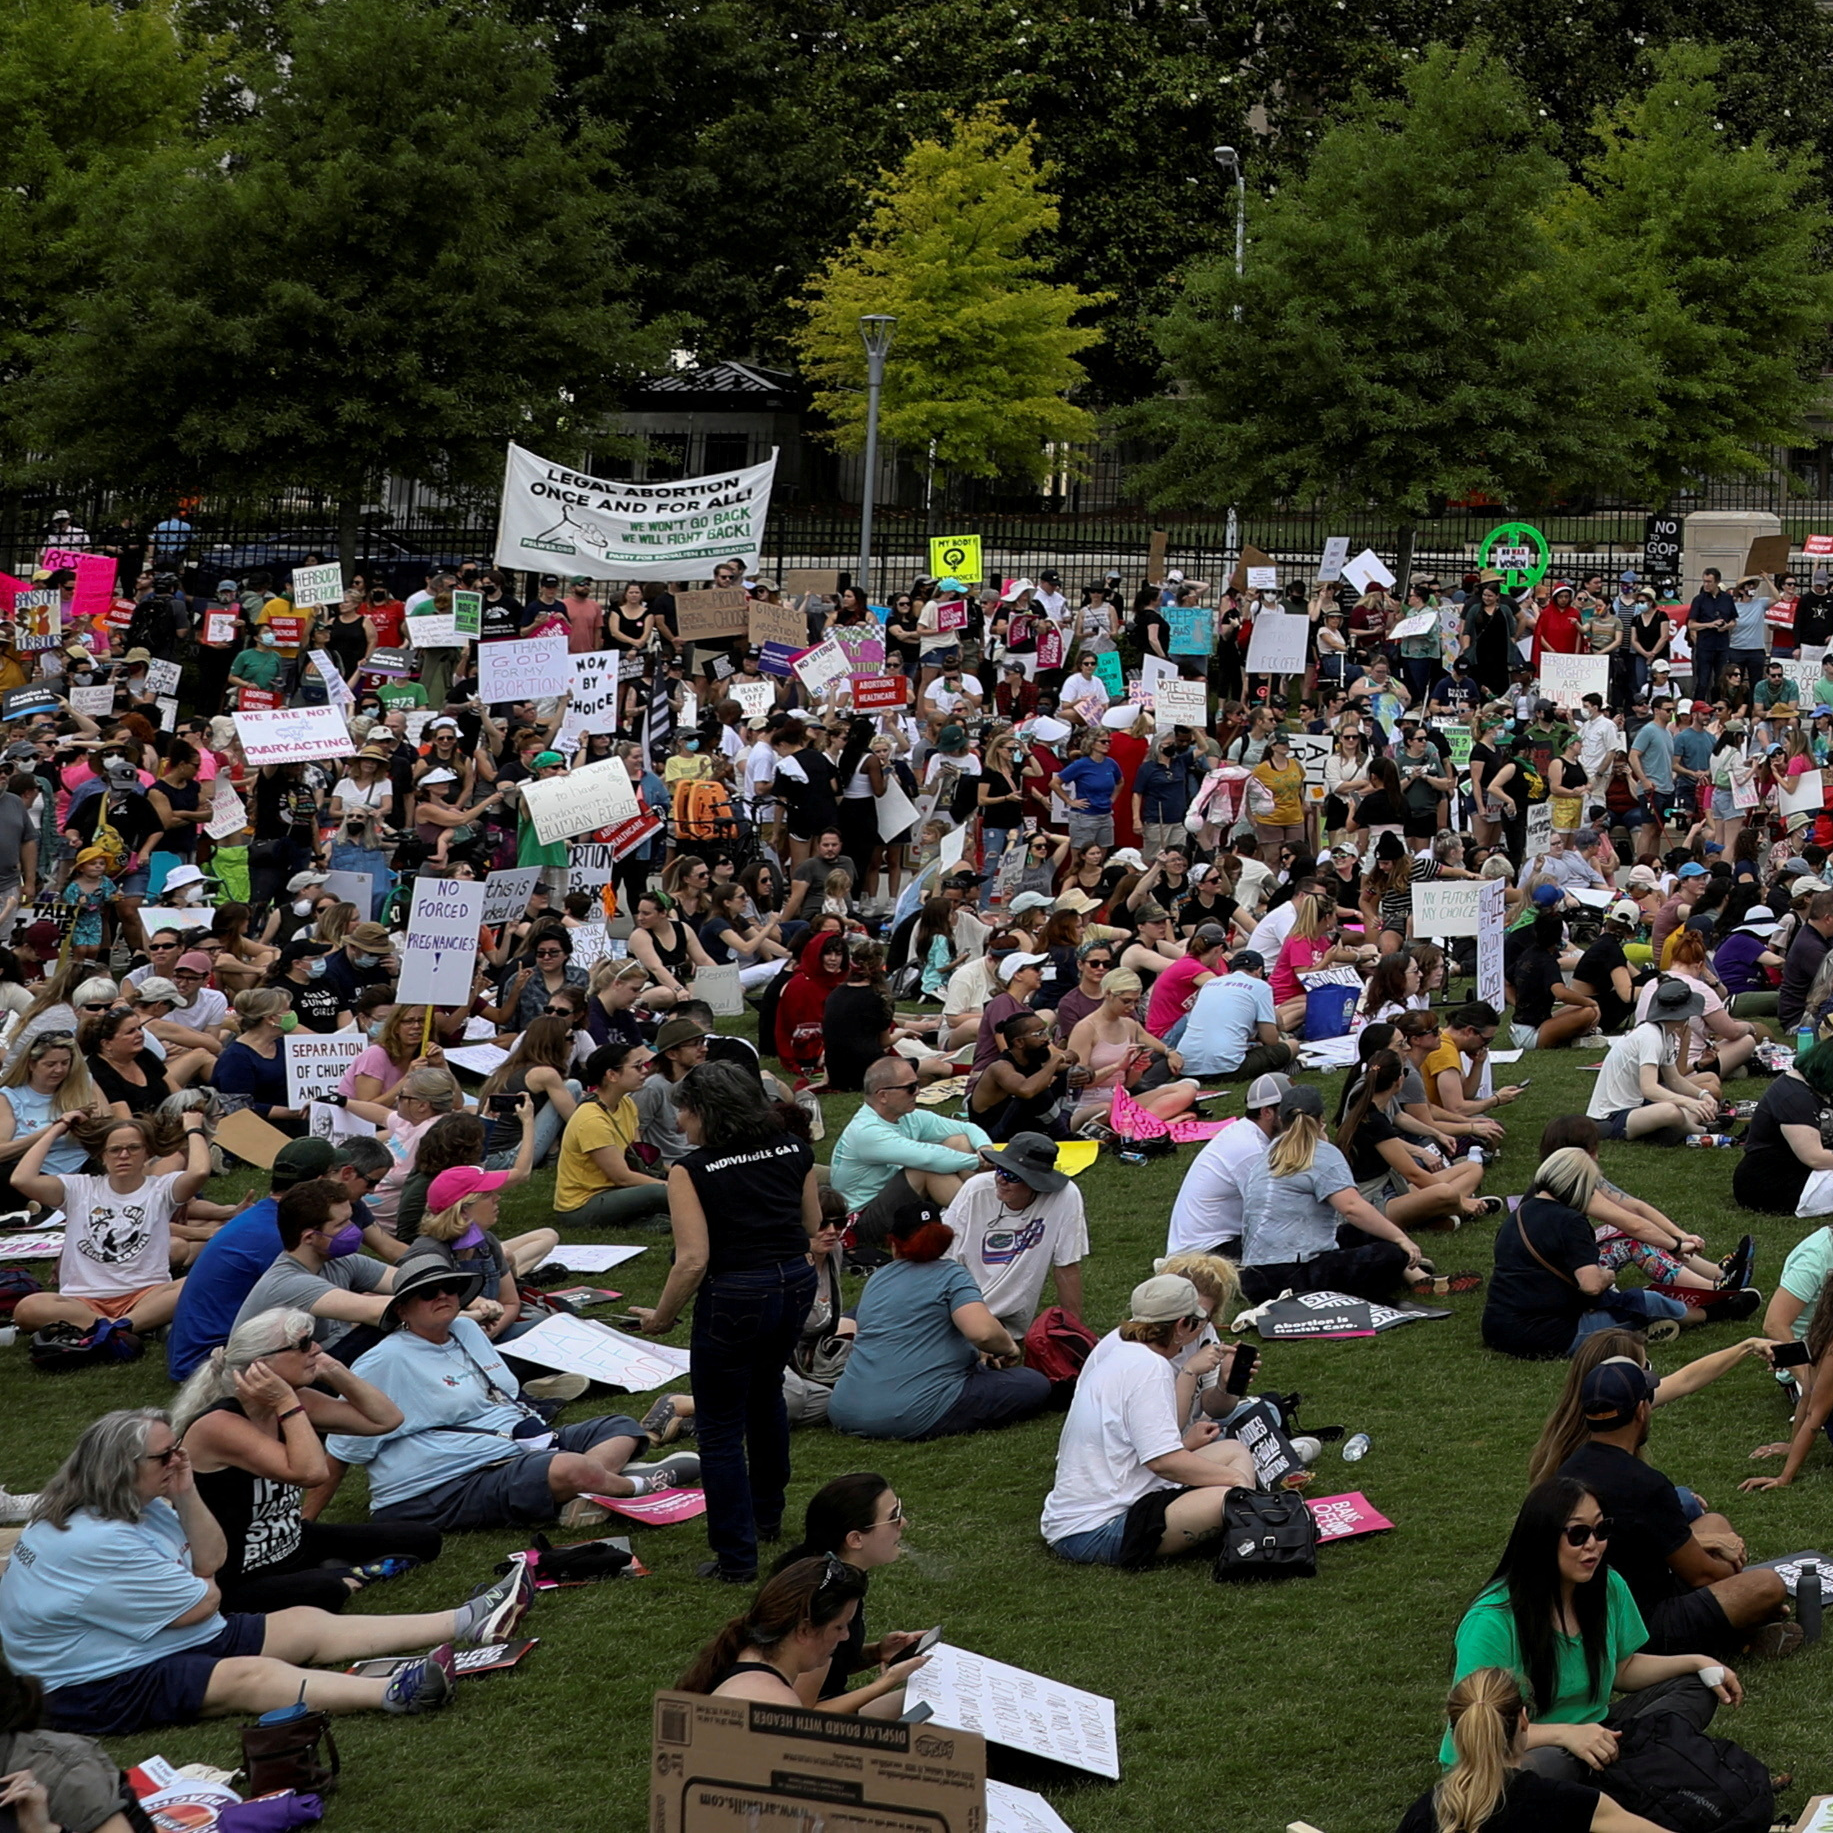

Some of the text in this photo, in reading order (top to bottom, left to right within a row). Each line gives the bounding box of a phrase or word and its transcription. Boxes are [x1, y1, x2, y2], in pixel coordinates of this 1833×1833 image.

[546, 468, 740, 498] LEGAL ABORTION
[530, 481, 752, 514] ONCE AND FOR ALL!
[629, 506, 751, 532] WE WON'T GO BACK
[621, 523, 751, 546] WE WILL FIGHT BACK!
[1654, 520, 1677, 535] NO
[1649, 533, 1660, 541] TO
[1646, 541, 1679, 556] GOP
[511, 639, 561, 654] THANK
[492, 652, 551, 668] GOD
[492, 666, 546, 678] FOR MY
[483, 675, 564, 699] ABORTION
[583, 676, 599, 690] BY
[858, 678, 895, 690] ABORTIONS
[1561, 680, 1582, 690] ARE
[858, 690, 897, 703] HEALTHCARE
[242, 707, 333, 722] WE ARE NOT
[244, 736, 351, 755] OVARY-ACTING
[537, 814, 595, 842] HUMAN
[570, 871, 583, 886] IS
[436, 880, 459, 896] NO
[485, 877, 530, 898] this is
[1423, 890, 1478, 905] MY FUTURE
[32, 902, 77, 919] TALK
[417, 898, 469, 918] FORCED
[1422, 905, 1477, 921] MY CHOICE
[407, 932, 476, 952] PREGNANCIES
[312, 1006, 336, 1016] GIRLS
[292, 1042, 363, 1058] SEPARATION
[296, 1063, 351, 1079] OF CHUR
[298, 1085, 322, 1100] AND
[1272, 1315, 1349, 1330] Abortion is
[253, 1477, 279, 1505] IF
[1331, 1500, 1364, 1525] BANS
[952, 1653, 984, 1698] EXCEEDS
[753, 1709, 907, 1744] DISPLAY BOARD WITH HEADER
[1677, 1787, 1722, 1818] patagonia
